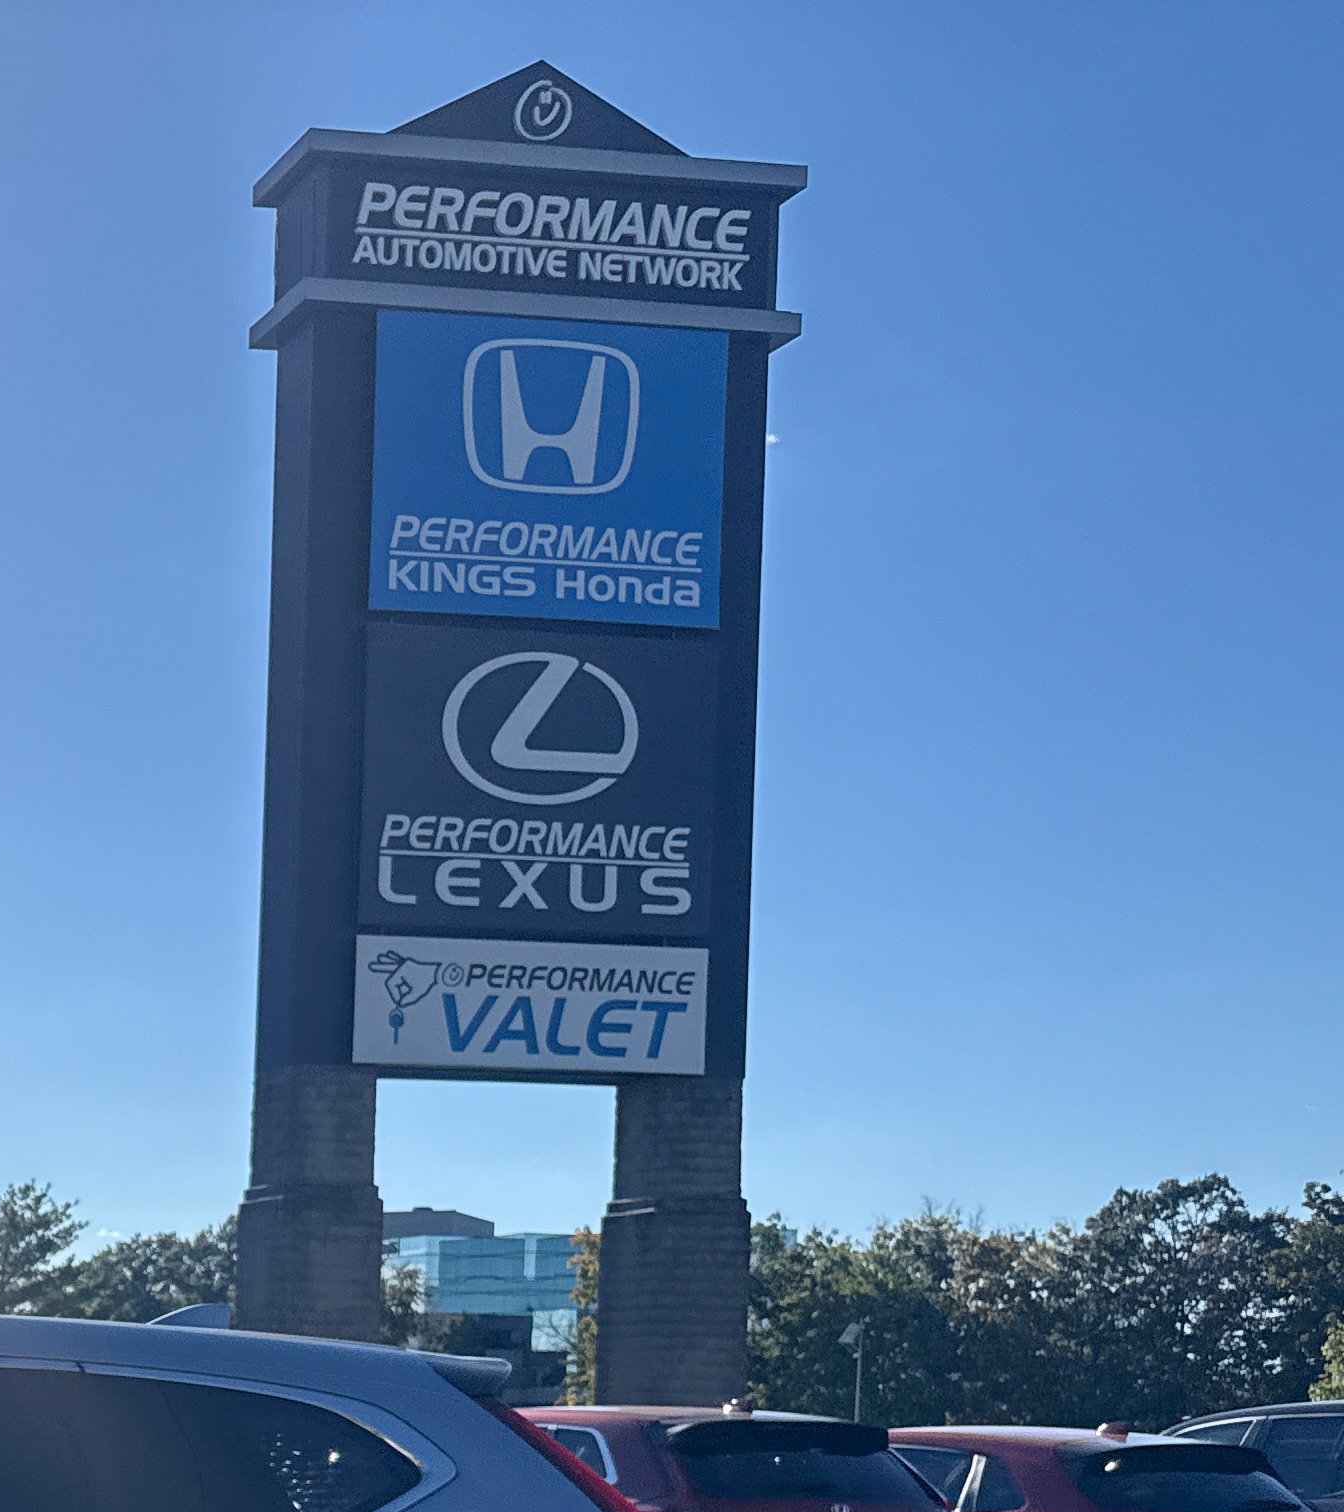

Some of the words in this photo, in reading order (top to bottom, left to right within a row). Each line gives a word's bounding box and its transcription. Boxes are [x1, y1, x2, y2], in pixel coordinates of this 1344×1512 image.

[355, 182, 752, 253] PERFORMANCE
[352, 235, 569, 279] AUTOMOTIVE
[577, 250, 743, 291] NETWORK
[389, 514, 703, 566] PERFORMANCE
[387, 558, 537, 598] KINGS
[555, 567, 701, 608] Honda
[379, 814, 691, 861] PERFORMANCE
[377, 855, 692, 916] LEXUS
[464, 963, 696, 996] PERFORMANCE
[441, 992, 688, 1060] VALET
